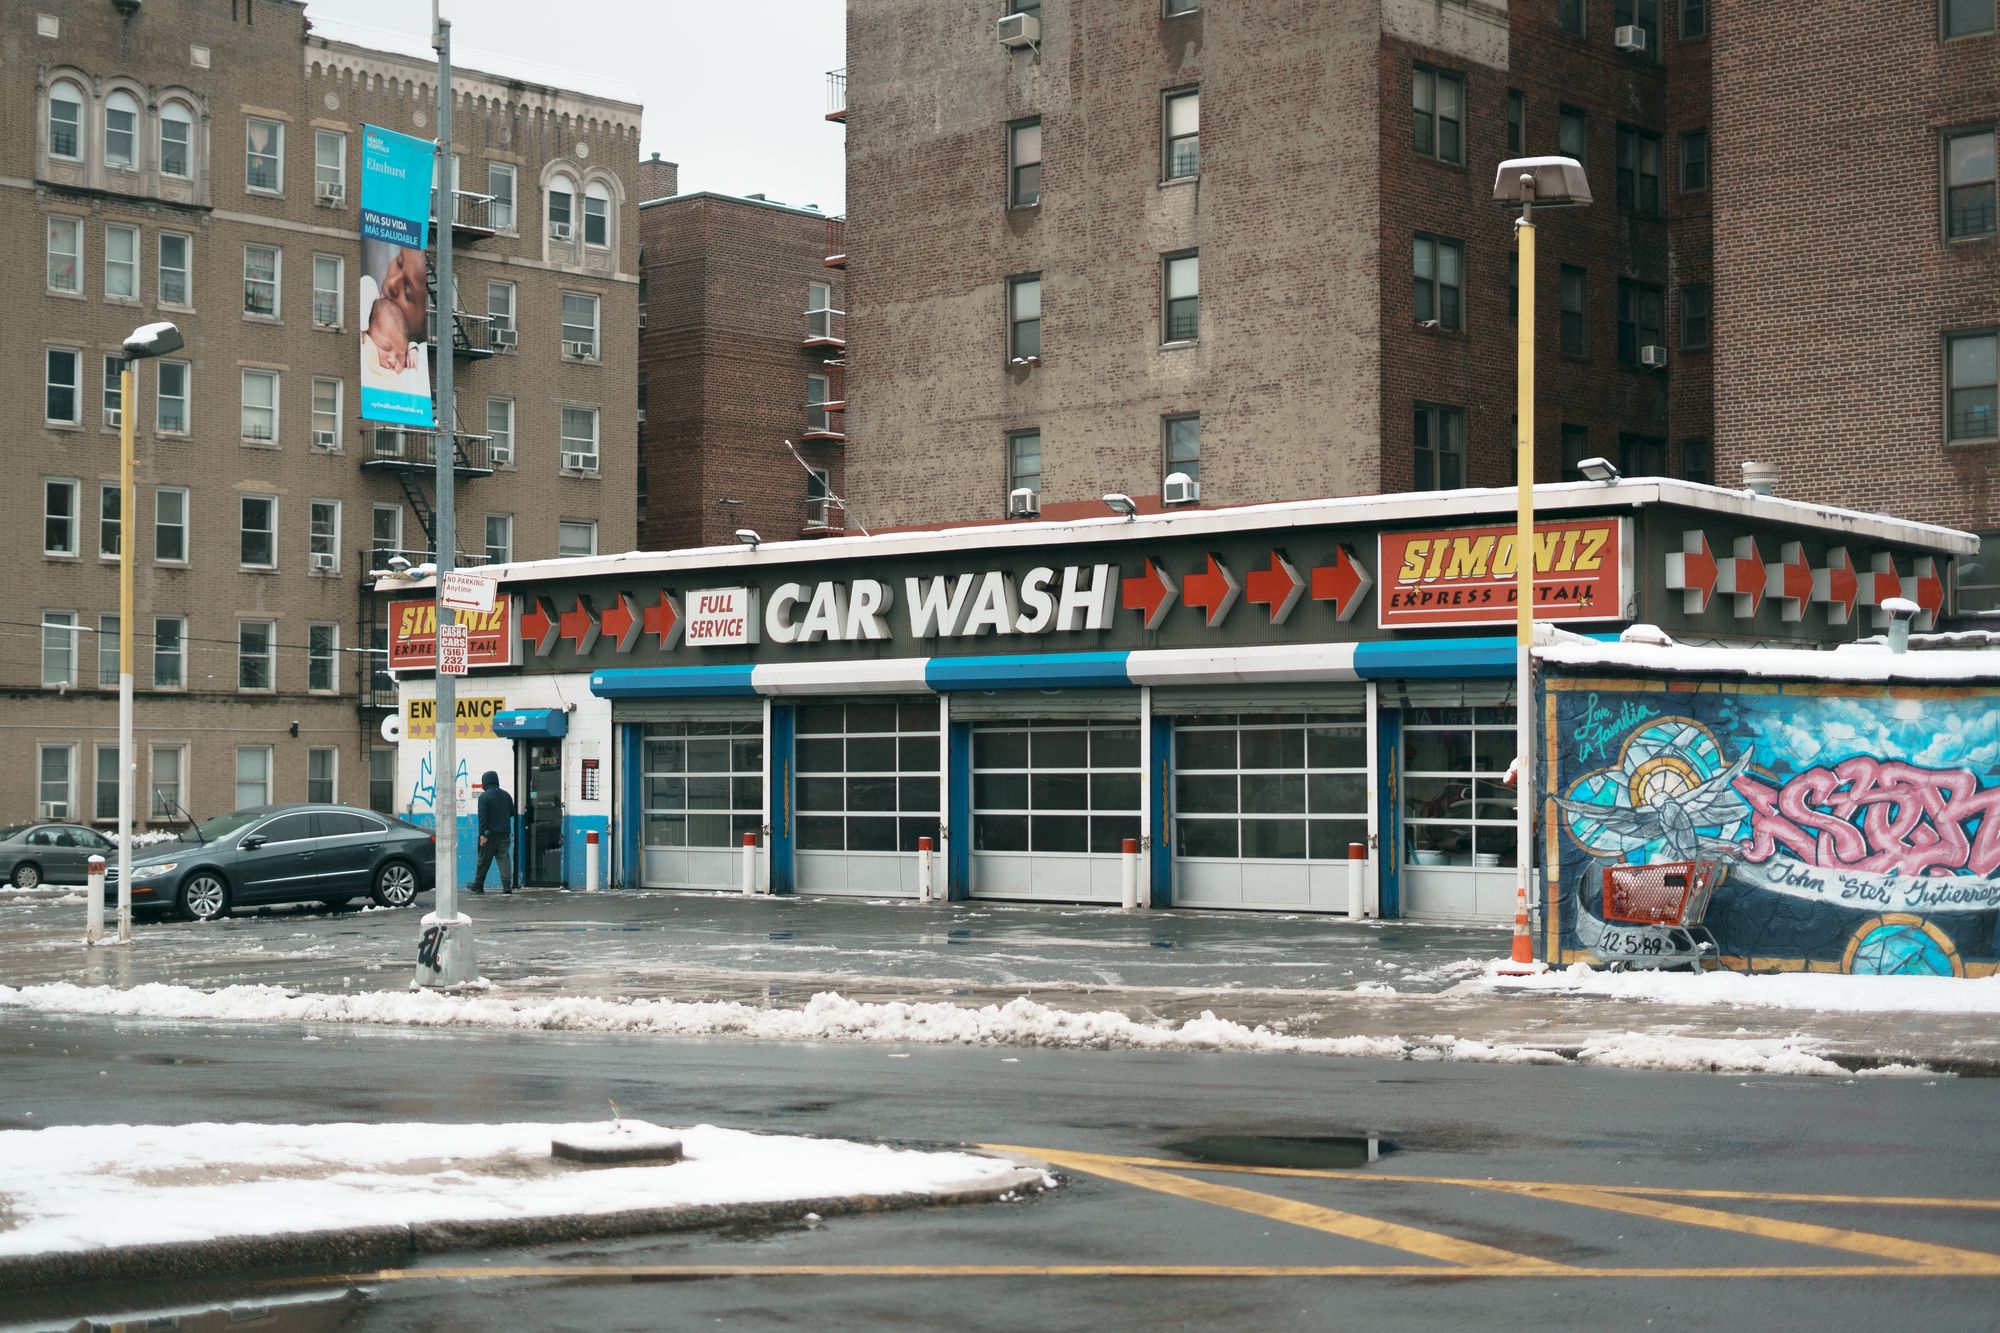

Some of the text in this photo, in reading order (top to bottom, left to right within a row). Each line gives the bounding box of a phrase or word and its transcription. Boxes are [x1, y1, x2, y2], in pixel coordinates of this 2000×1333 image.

[367, 157, 406, 178] Elmhurst
[365, 212, 408, 232] VIVA SU VIDA
[365, 224, 418, 245] MÁS SALUDABLE
[1397, 528, 1610, 584] SIMONIZ
[446, 584, 472, 594] Anytime
[447, 576, 485, 587] NO PARKING
[699, 594, 734, 614] FULL
[766, 563, 1119, 643] CAR WASH
[1391, 584, 1595, 608] EXPRESS DTAIL
[442, 627, 466, 638] CASH 4
[690, 617, 743, 639] SERVICE
[442, 637, 466, 648] CARS
[443, 648, 465, 657] (516)
[469, 640, 498, 652] TAIL
[441, 664, 466, 673] 0007
[444, 656, 463, 664] 232
[410, 699, 503, 719] ENANCE
[1591, 700, 1661, 760] Familia
[1766, 862, 1825, 893] John
[1903, 879, 2000, 906] Gutierrez
